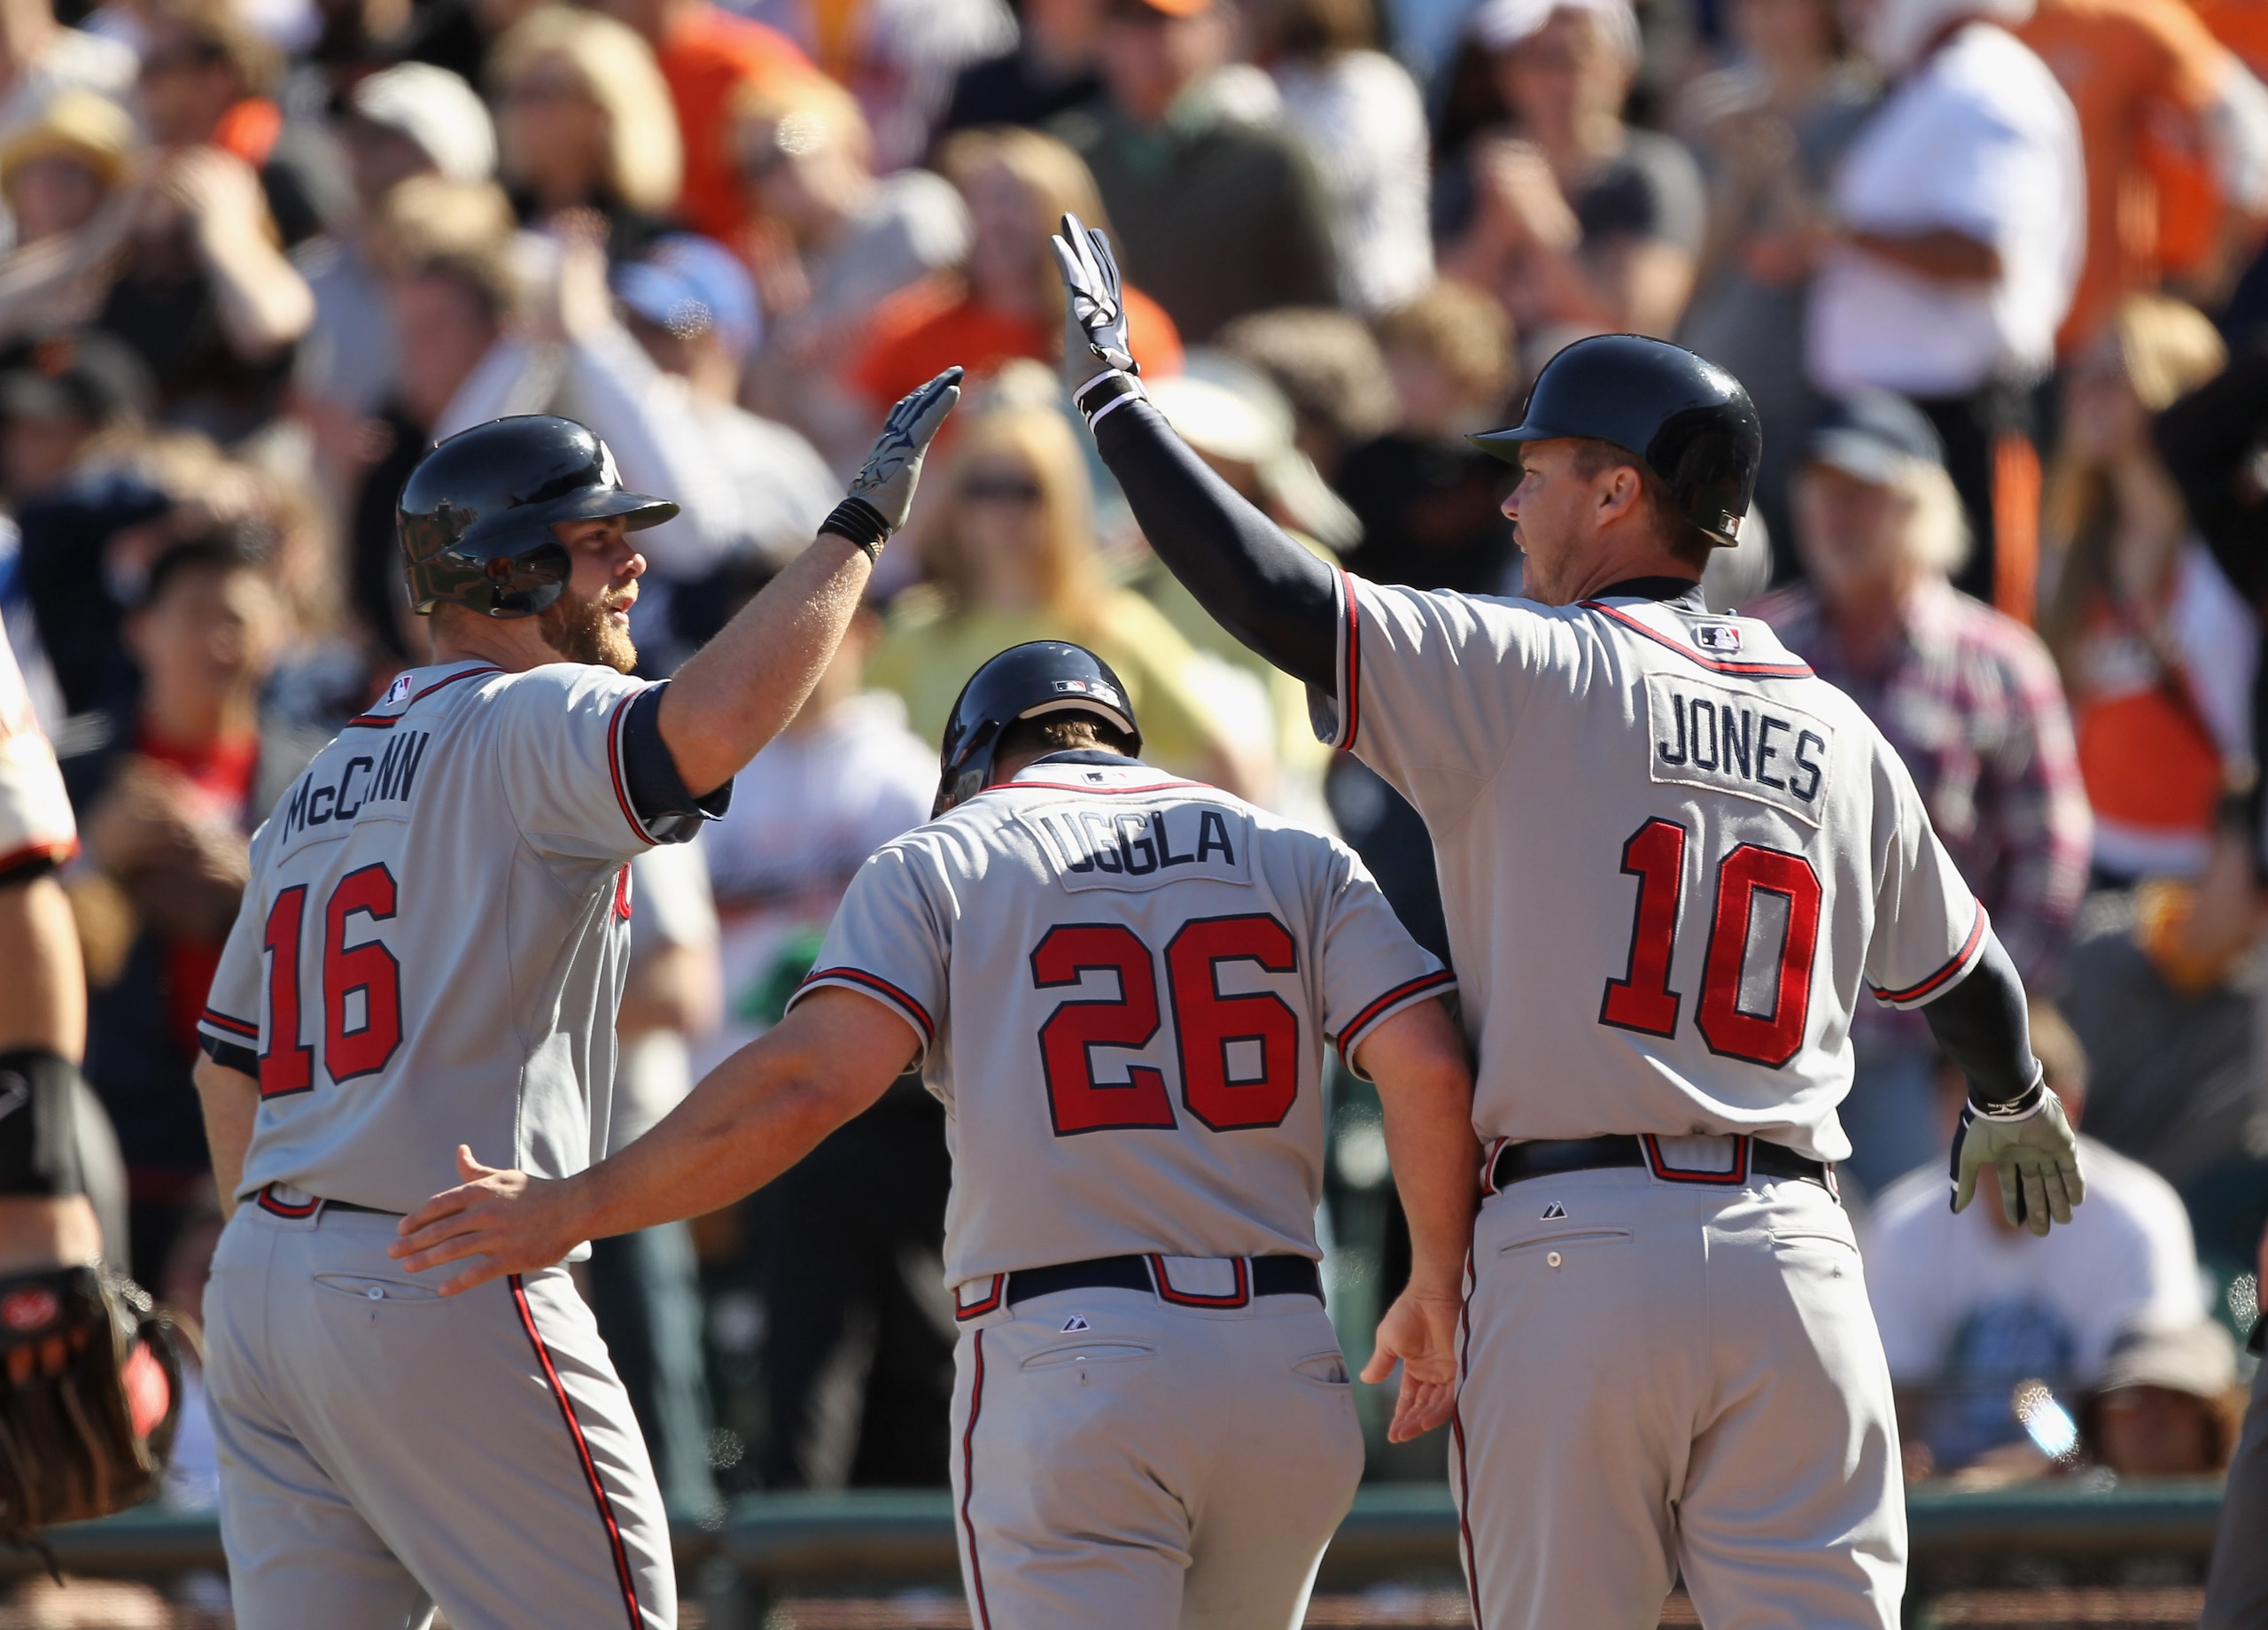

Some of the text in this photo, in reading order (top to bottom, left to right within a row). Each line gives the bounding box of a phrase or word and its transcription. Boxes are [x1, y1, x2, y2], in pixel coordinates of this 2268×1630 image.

[283, 731, 431, 845] McCNN
[1659, 695, 1825, 802] JONES
[1039, 811, 1235, 875] UGGLA
[260, 862, 404, 1101] 16
[1029, 912, 1298, 1137] 26
[1598, 816, 1821, 1070] 10
